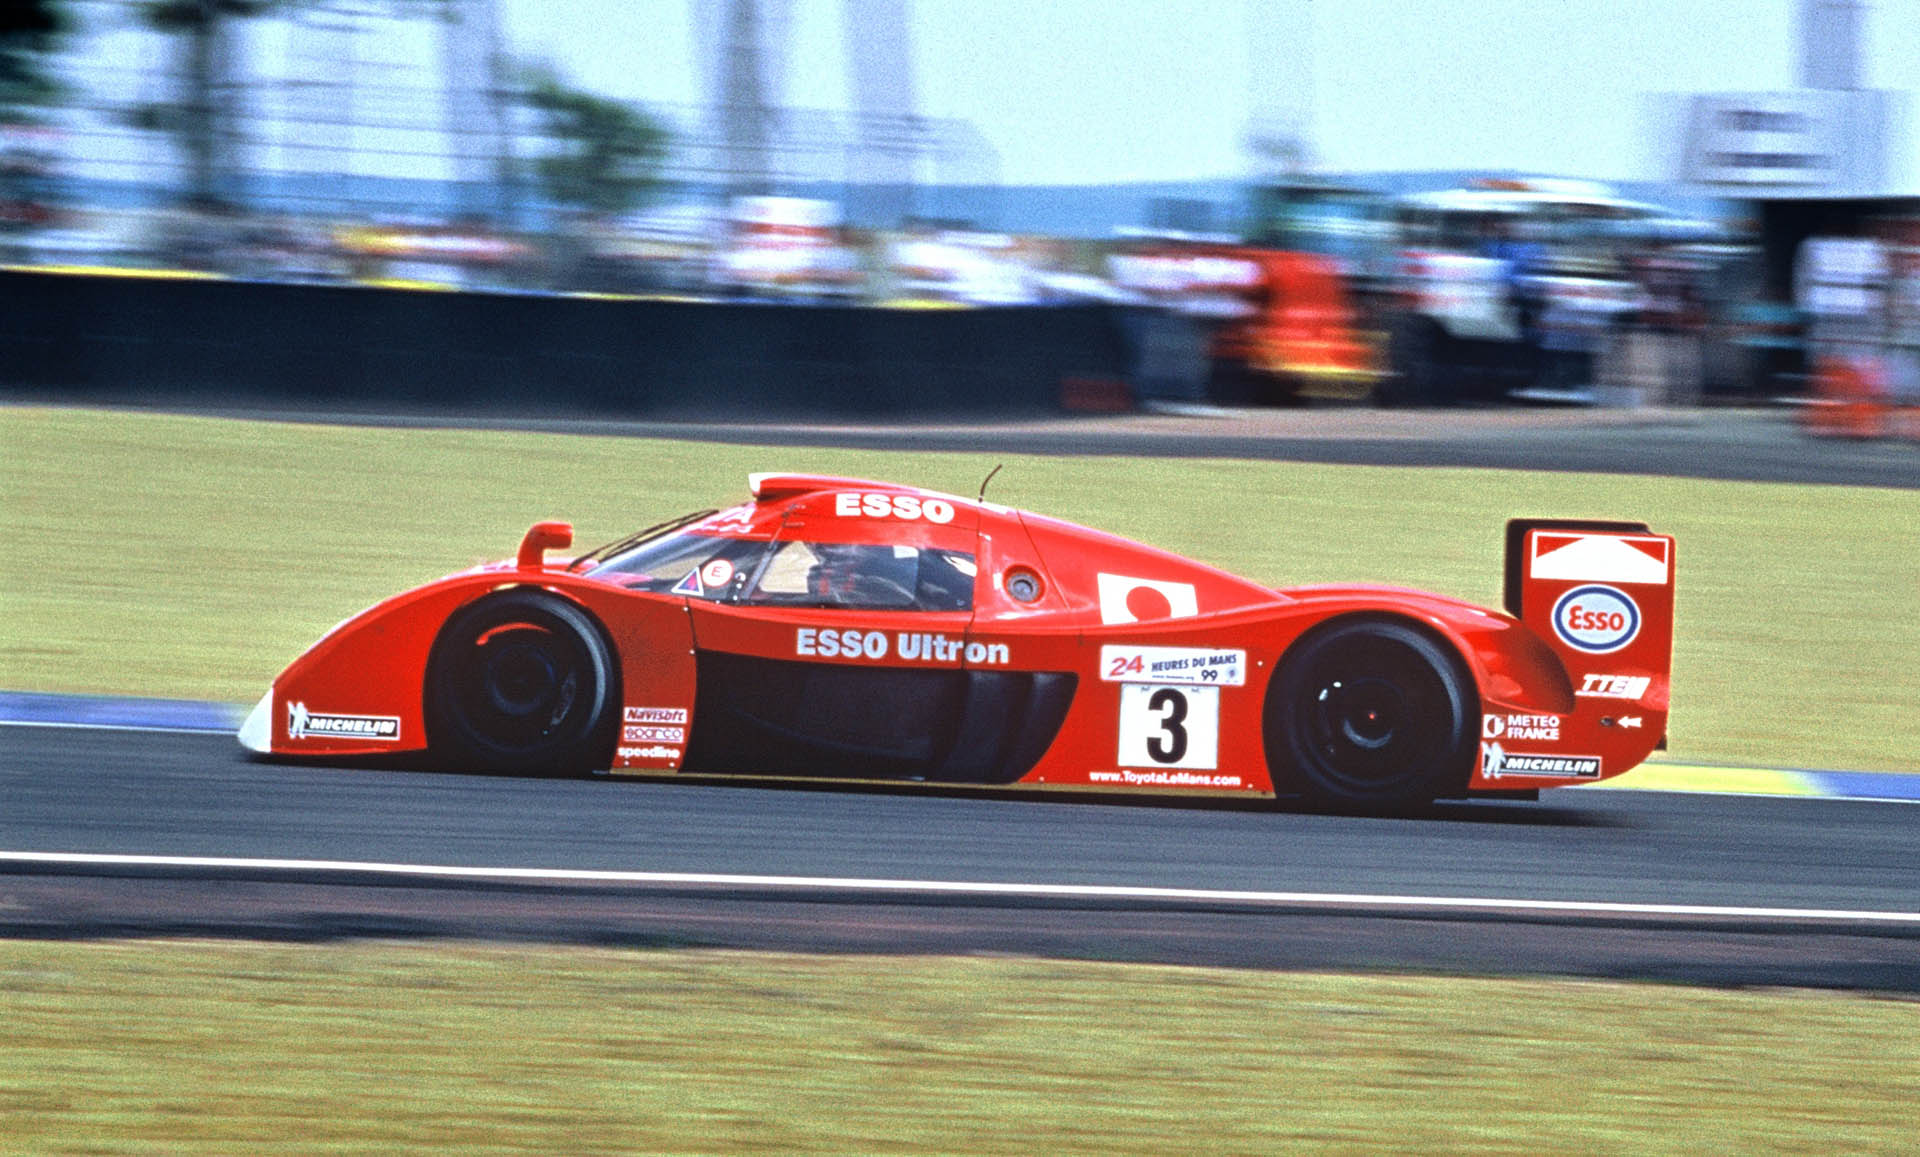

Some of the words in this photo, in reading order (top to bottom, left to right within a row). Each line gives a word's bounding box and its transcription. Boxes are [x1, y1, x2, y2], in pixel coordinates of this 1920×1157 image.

[835, 493, 955, 524] ESSO
[710, 565, 723, 579] E
[1568, 605, 1625, 631] Esso
[796, 628, 888, 660] ESSO
[898, 633, 1009, 664] Ultron
[1108, 655, 1145, 677] 24
[1151, 658, 1189, 673] HEURES
[1192, 657, 1206, 668] DU
[1208, 654, 1237, 666] MANS
[1201, 669, 1218, 681] 99
[309, 718, 396, 734] MICHELIN
[1147, 687, 1189, 764] 3
[1507, 715, 1560, 728] METEO
[1507, 728, 1560, 740] FRANCE
[1505, 757, 1597, 773] MICHELIN
[1089, 770, 1242, 786] www.ToyotaLeMans.com
